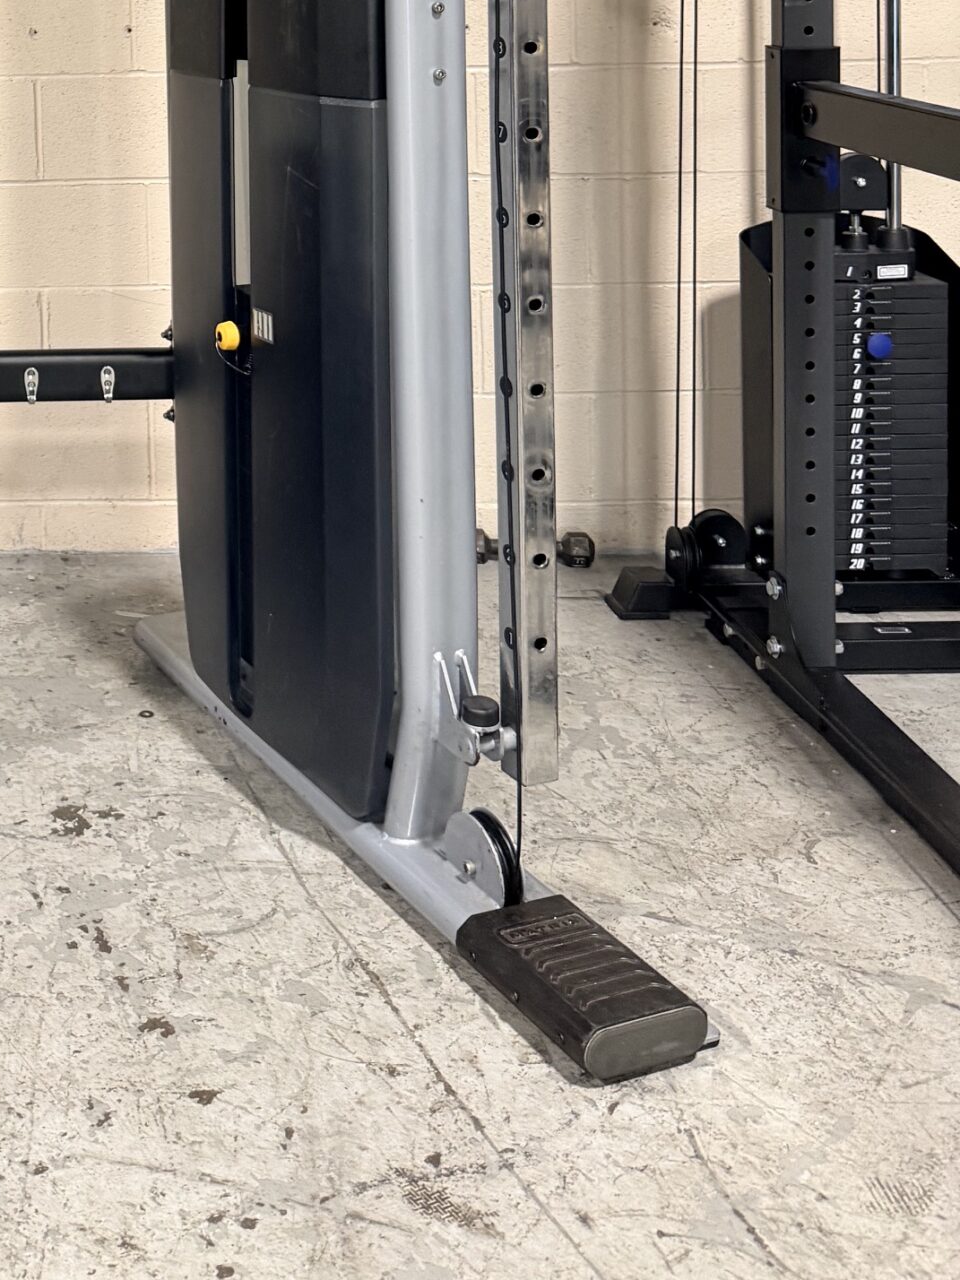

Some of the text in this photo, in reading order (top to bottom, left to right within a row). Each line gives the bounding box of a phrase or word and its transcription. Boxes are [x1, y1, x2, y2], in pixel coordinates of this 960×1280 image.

[846, 266, 853, 277] 1
[852, 289, 860, 300] 2
[852, 302, 861, 313] 3
[853, 317, 862, 328] 4
[852, 333, 862, 344] 5
[852, 348, 862, 359] 6
[853, 363, 861, 374] 7
[852, 379, 861, 390] 8
[853, 392, 862, 404] 9
[850, 408, 864, 419] 10
[850, 423, 861, 434] 11
[850, 439, 863, 449] 12
[850, 454, 863, 465] 13
[850, 468, 863, 479] 14
[851, 484, 864, 494] 15
[851, 499, 864, 510] 16
[850, 513, 863, 524] 17
[850, 528, 863, 539] 18
[850, 543, 863, 554] 19
[849, 558, 865, 569] 20
